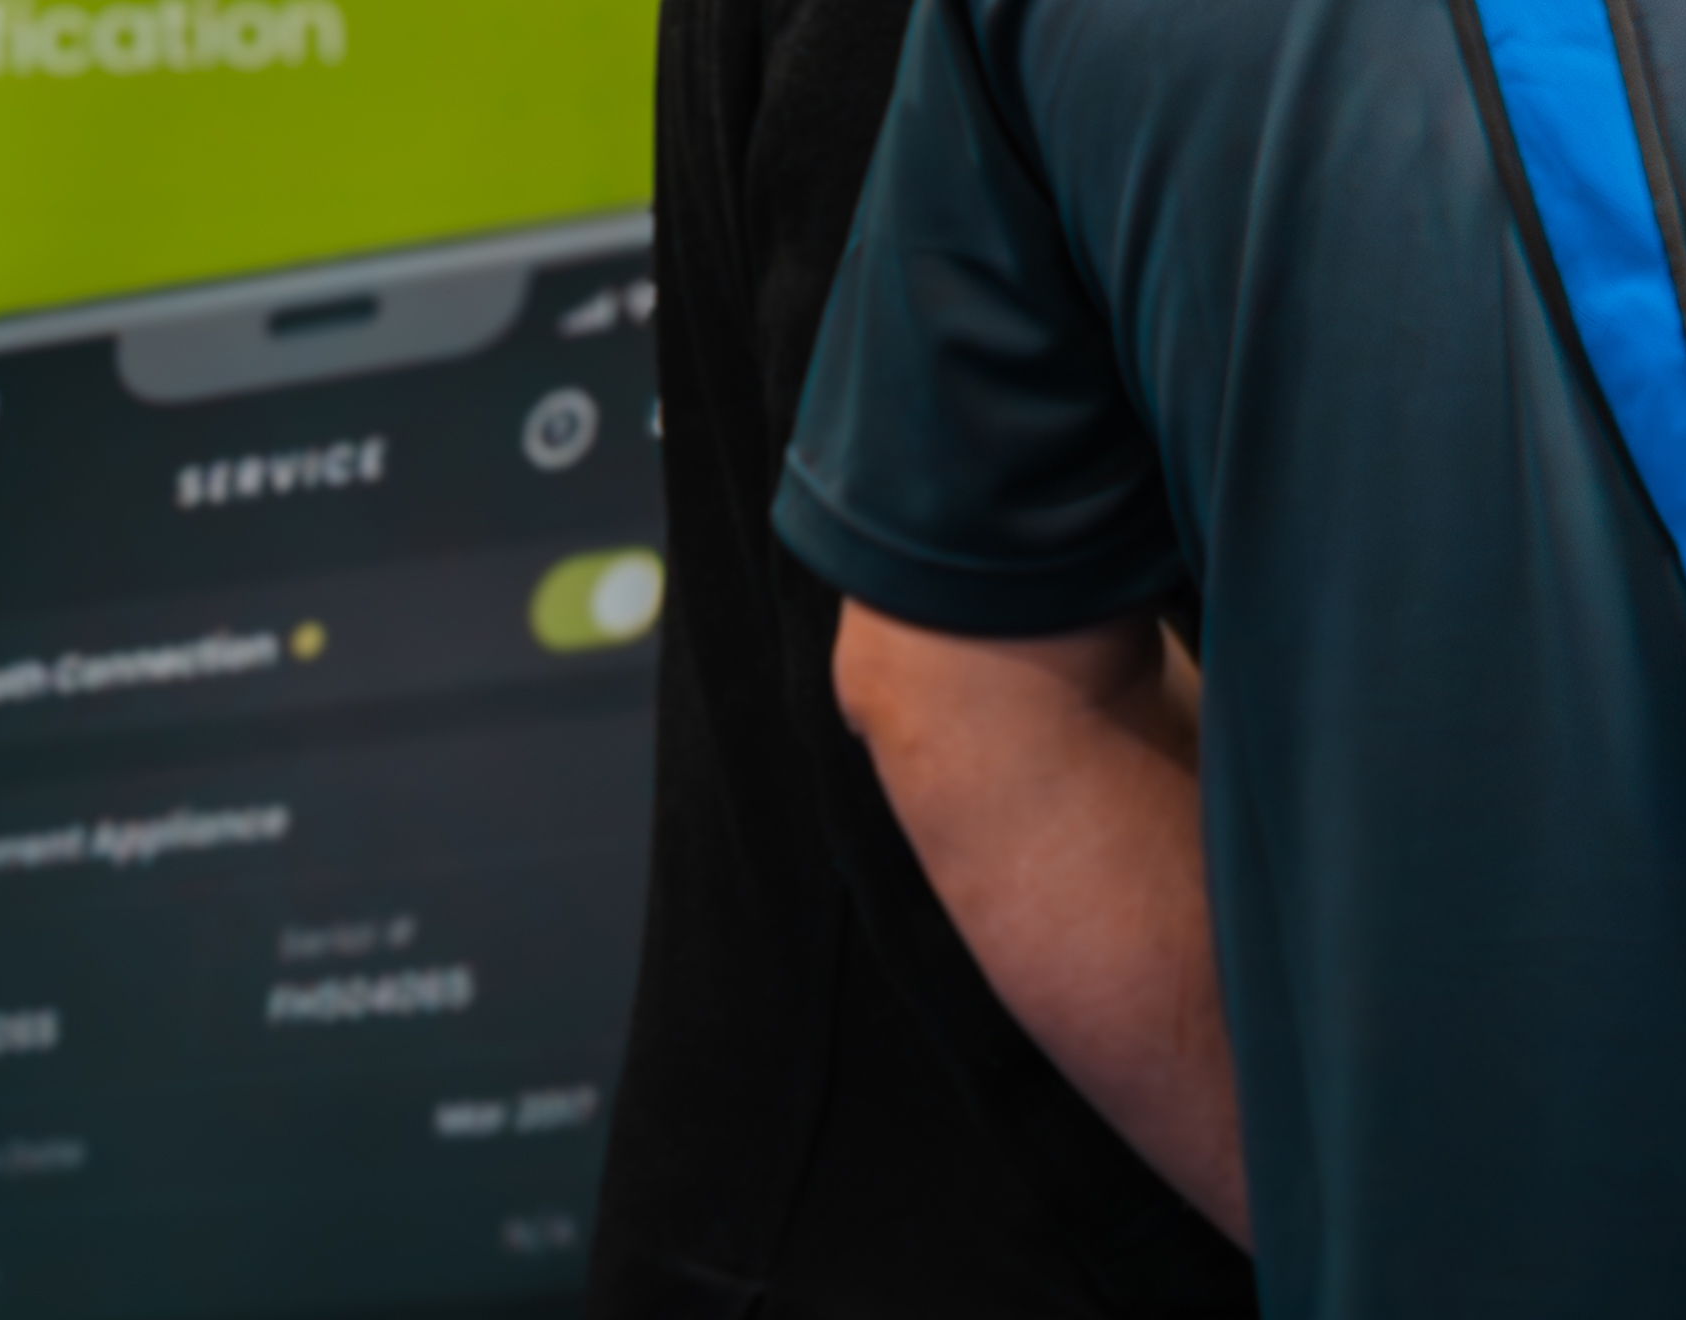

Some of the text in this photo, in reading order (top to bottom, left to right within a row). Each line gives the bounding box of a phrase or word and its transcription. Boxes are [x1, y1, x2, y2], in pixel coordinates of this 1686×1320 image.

[175, 436, 387, 510] SERVICE
[52, 626, 280, 698] Connection
[90, 802, 290, 868] Appliance
